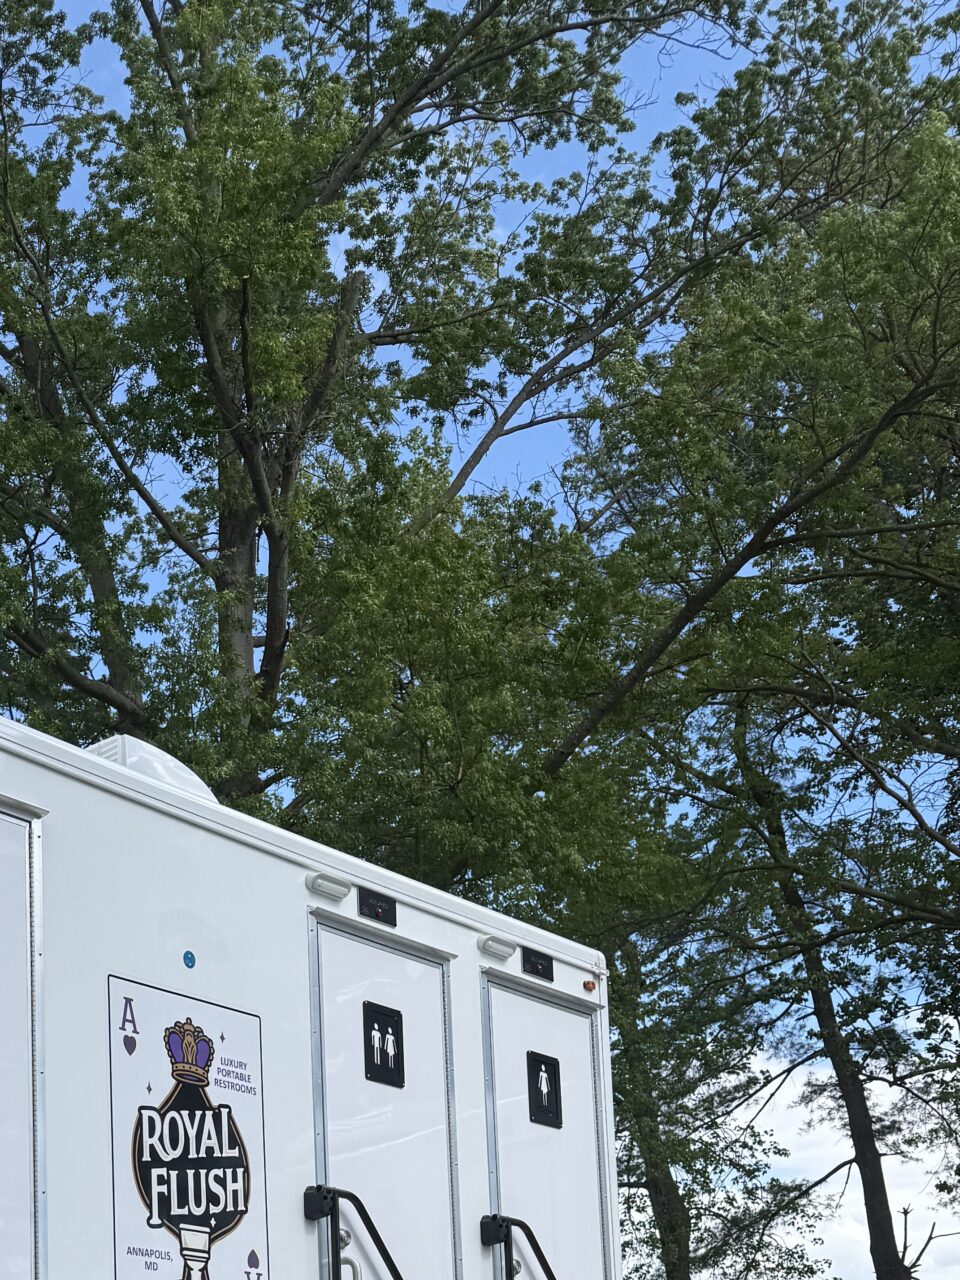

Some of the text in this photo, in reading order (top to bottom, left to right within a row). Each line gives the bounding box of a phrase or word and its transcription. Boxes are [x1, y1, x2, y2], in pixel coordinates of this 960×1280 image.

[119, 996, 139, 1035] A
[220, 1056, 247, 1071] LUXURY
[216, 1067, 252, 1083] PORTABLE
[214, 1078, 257, 1096] RESTROOMS
[140, 1107, 239, 1162] ROYAL
[150, 1166, 246, 1226] FLUSH
[126, 1246, 174, 1263] ANNAPOLIS,
[144, 1260, 159, 1271] MD
